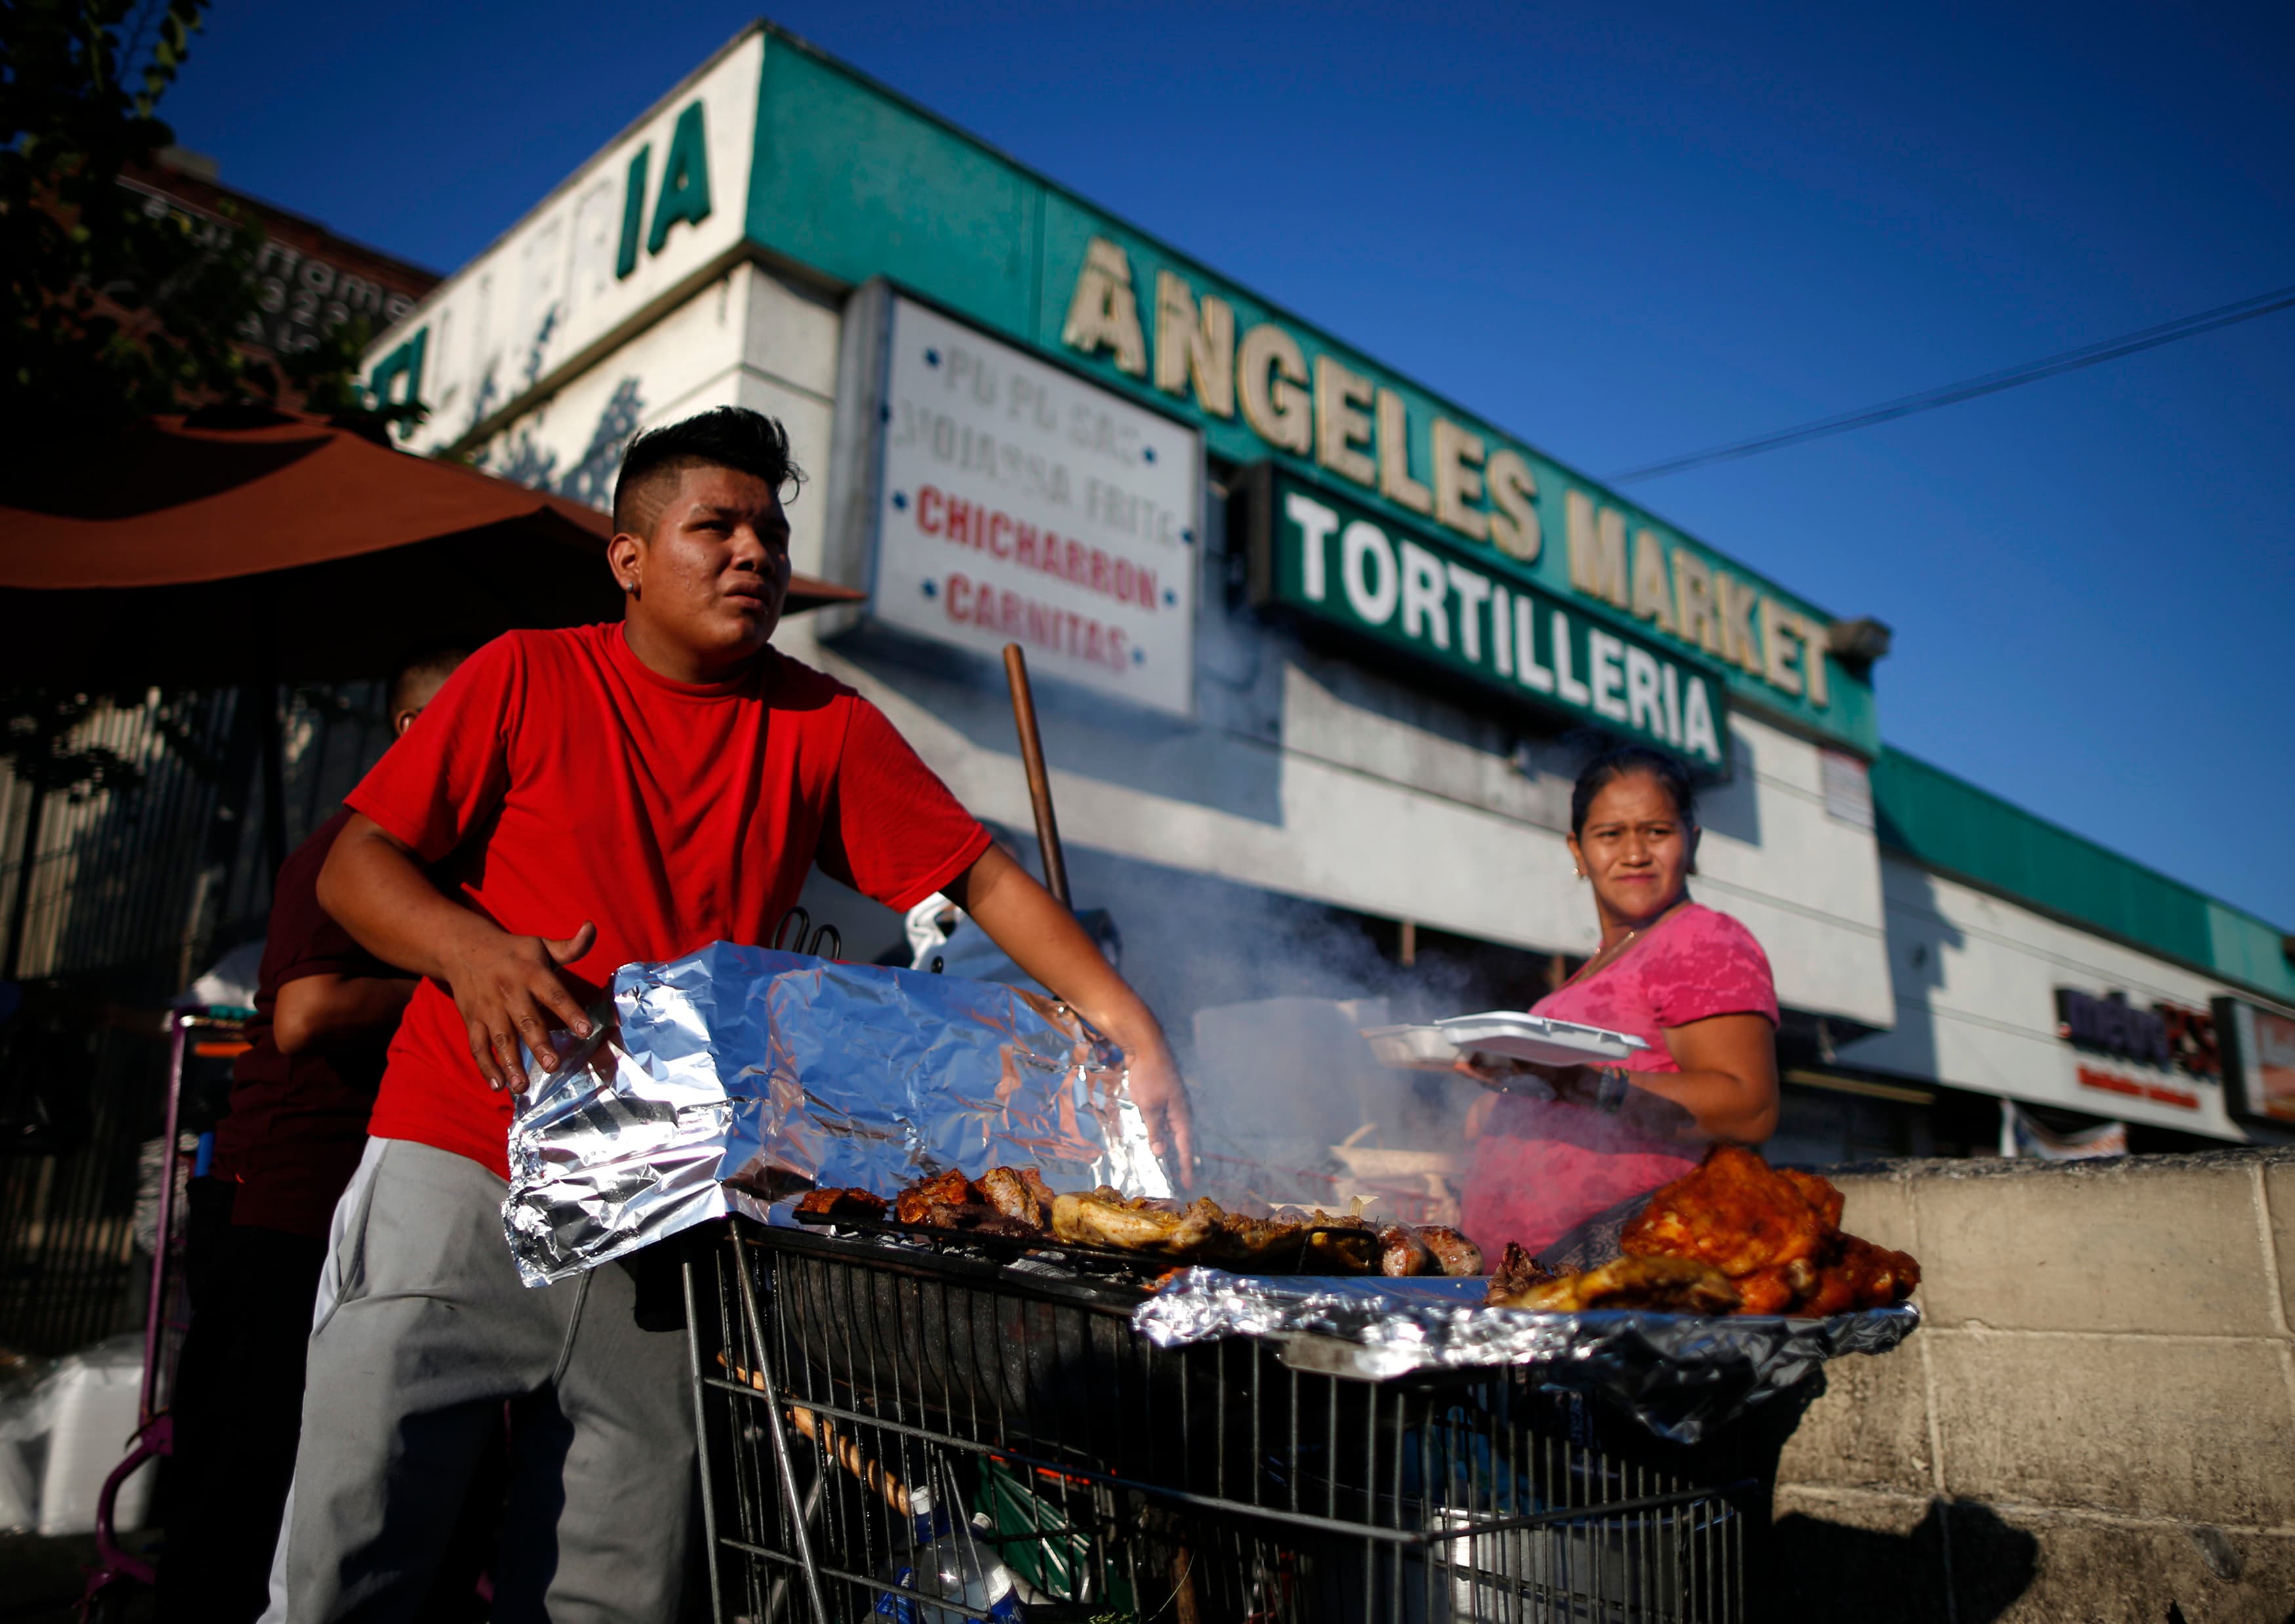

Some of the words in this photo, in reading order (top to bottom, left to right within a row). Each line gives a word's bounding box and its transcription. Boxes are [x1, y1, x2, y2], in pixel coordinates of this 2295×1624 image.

[917, 485, 1159, 610] CHICHARRON
[1063, 236, 1541, 563] ANGELES
[1565, 488, 1829, 707] MARKET
[944, 572, 1128, 671] CARNITAS
[1286, 492, 1722, 763] TORTILLERIA
